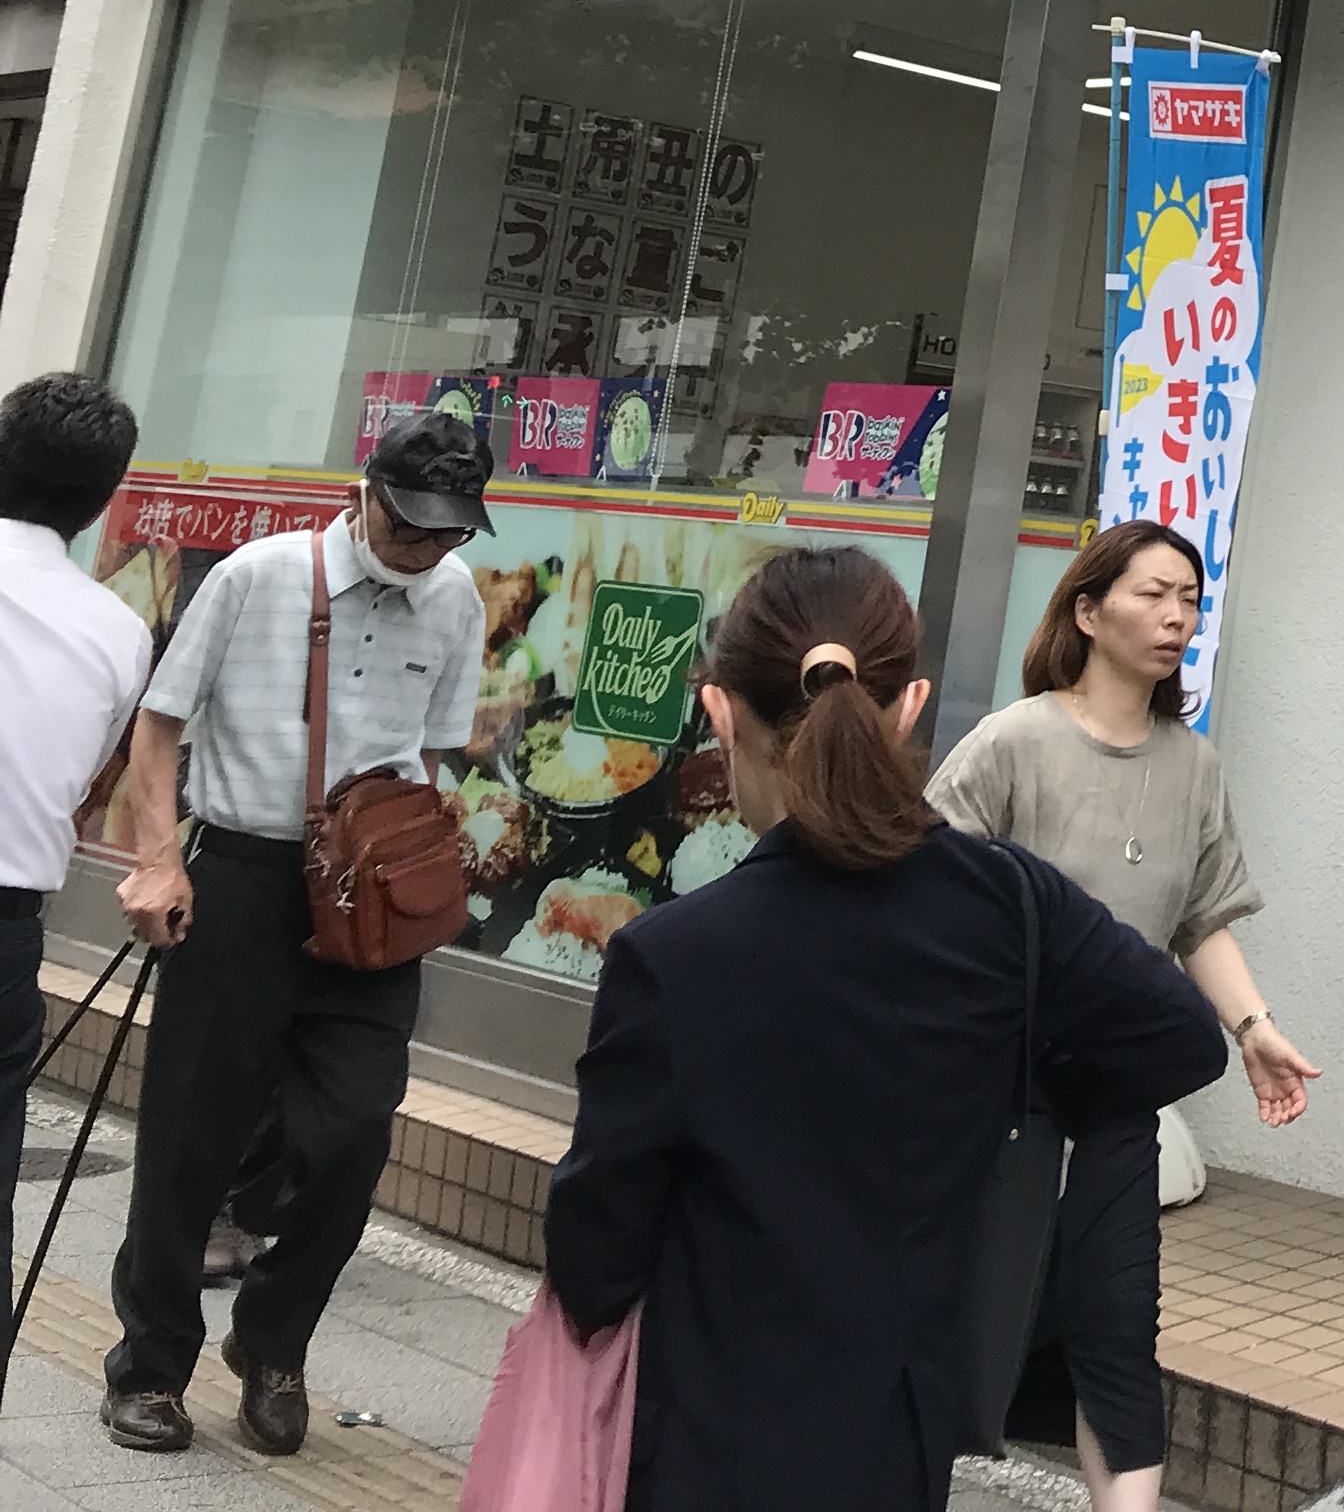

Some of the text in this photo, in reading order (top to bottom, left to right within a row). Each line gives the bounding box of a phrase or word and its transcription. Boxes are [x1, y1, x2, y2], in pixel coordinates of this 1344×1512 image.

[1173, 97, 1242, 128] ヤマザキ
[519, 398, 557, 450] BR
[816, 410, 866, 461] BR
[1158, 299, 1201, 529] いきい
[1113, 437, 1150, 525] キャ
[741, 491, 785, 524] Daily
[602, 602, 662, 664] Daily
